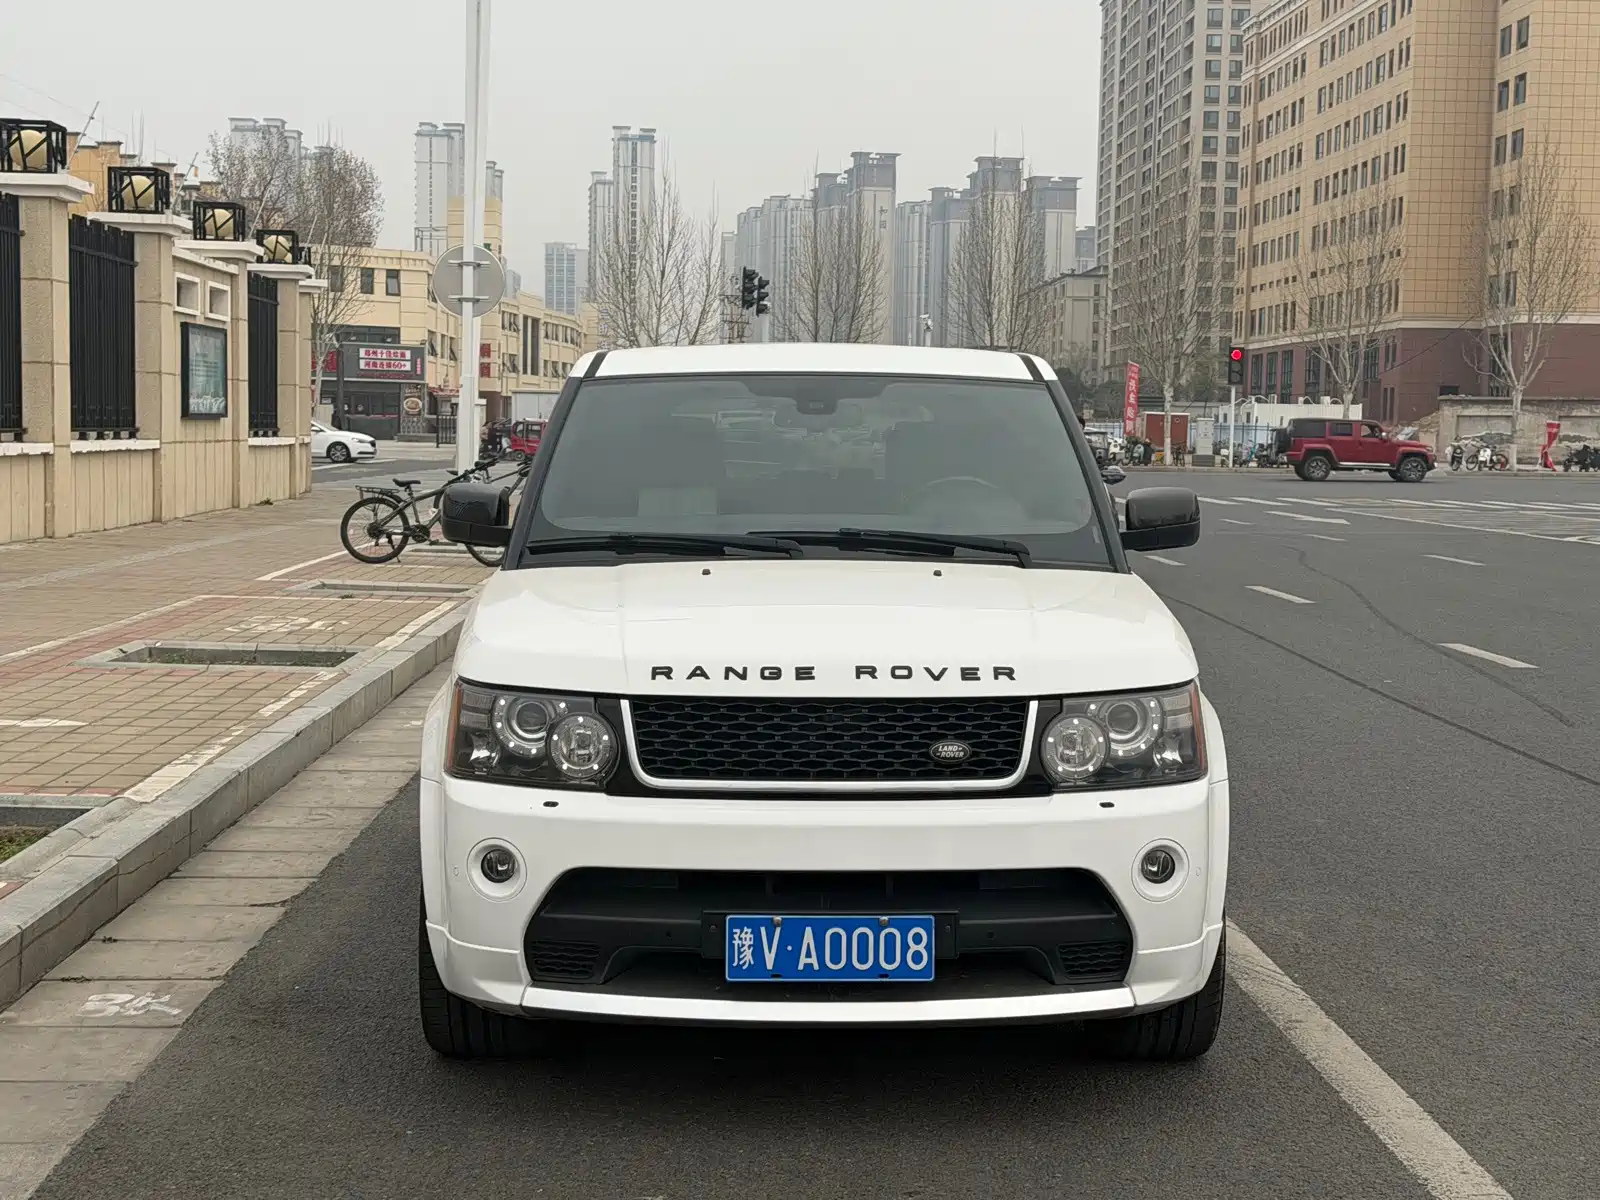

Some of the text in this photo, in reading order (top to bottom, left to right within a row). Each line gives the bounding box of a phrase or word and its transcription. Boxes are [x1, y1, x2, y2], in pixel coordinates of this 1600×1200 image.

[650, 665, 1017, 681] RANGE ROVER
[732, 926, 929, 971] 豫V·A0008
